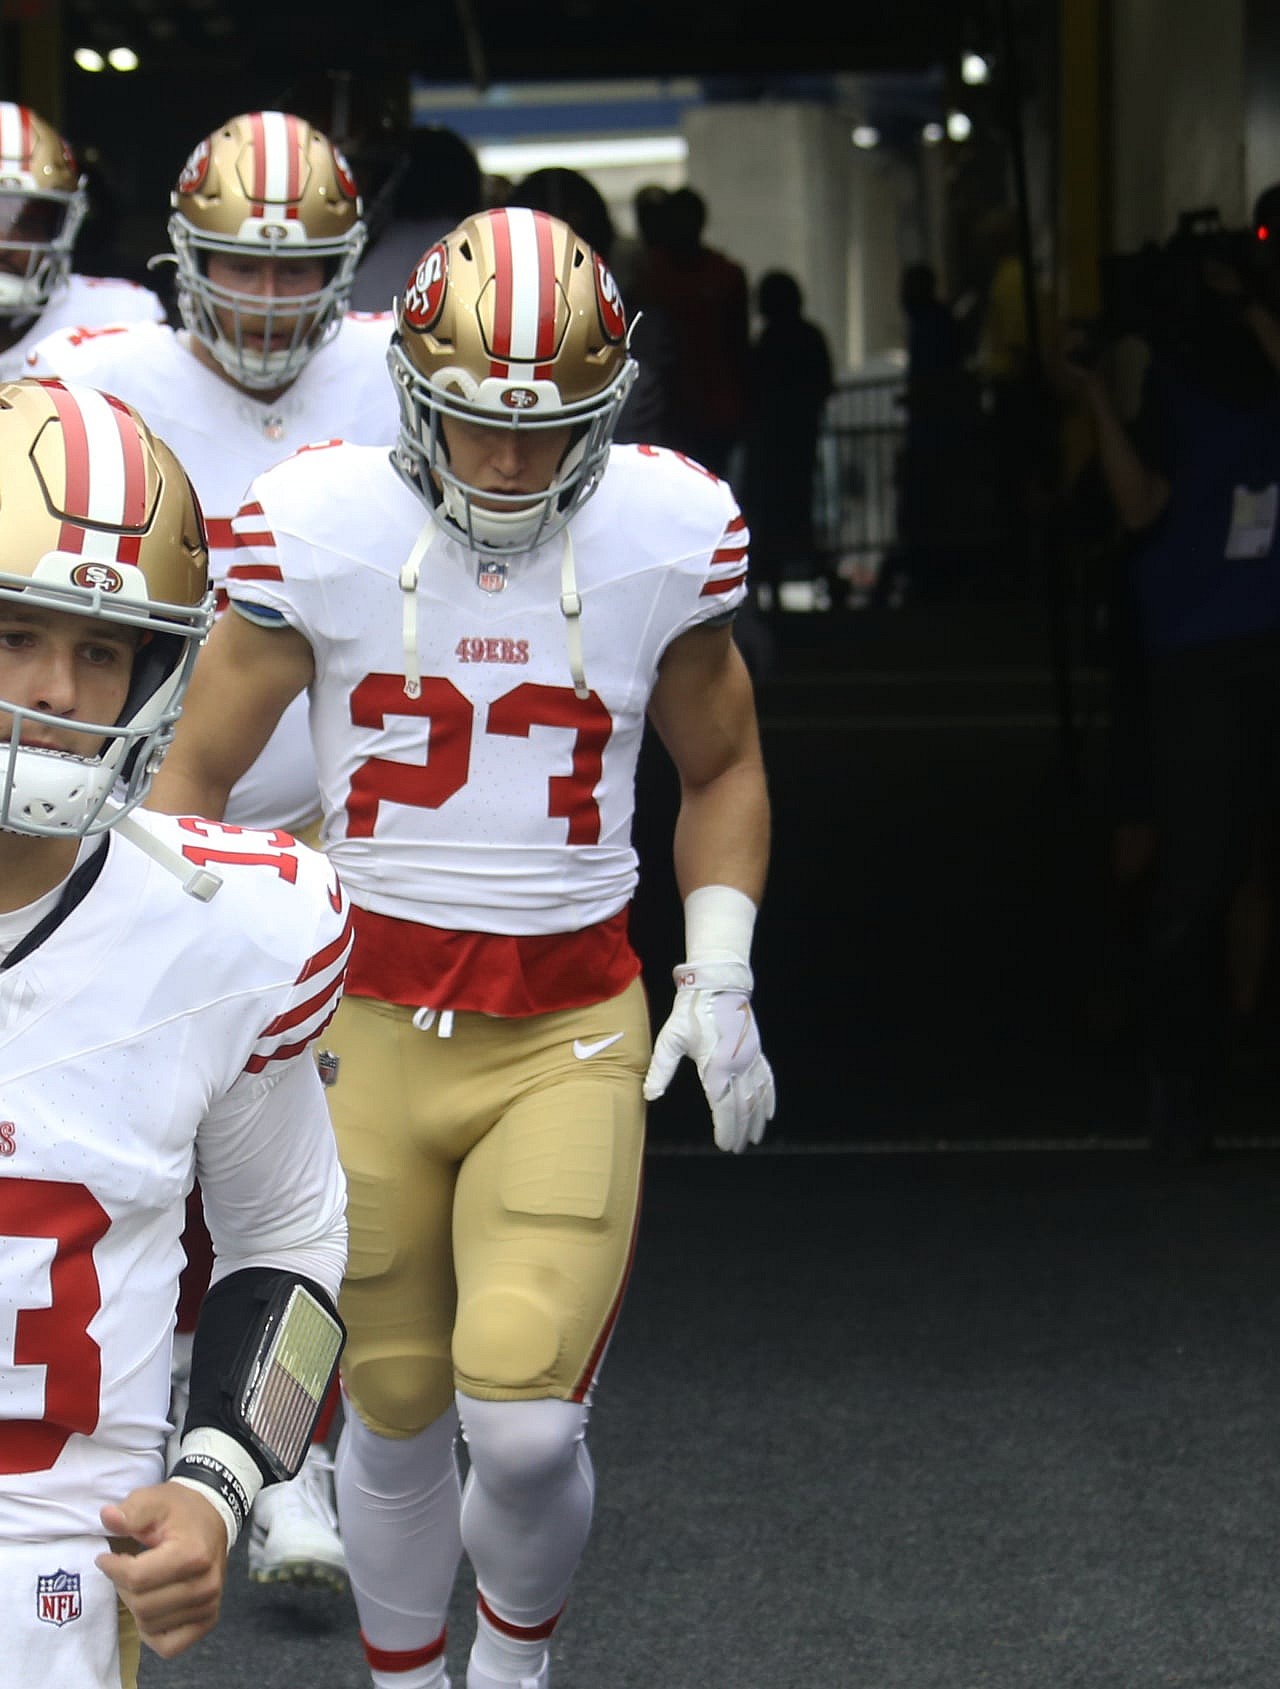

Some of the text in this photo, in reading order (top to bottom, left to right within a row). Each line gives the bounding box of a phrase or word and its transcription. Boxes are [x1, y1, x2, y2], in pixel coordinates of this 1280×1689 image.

[455, 637, 530, 665] 49ERS
[345, 672, 613, 846] 23
[185, 1455, 223, 1472] AFRAID
[41, 1594, 80, 1621] NFL
